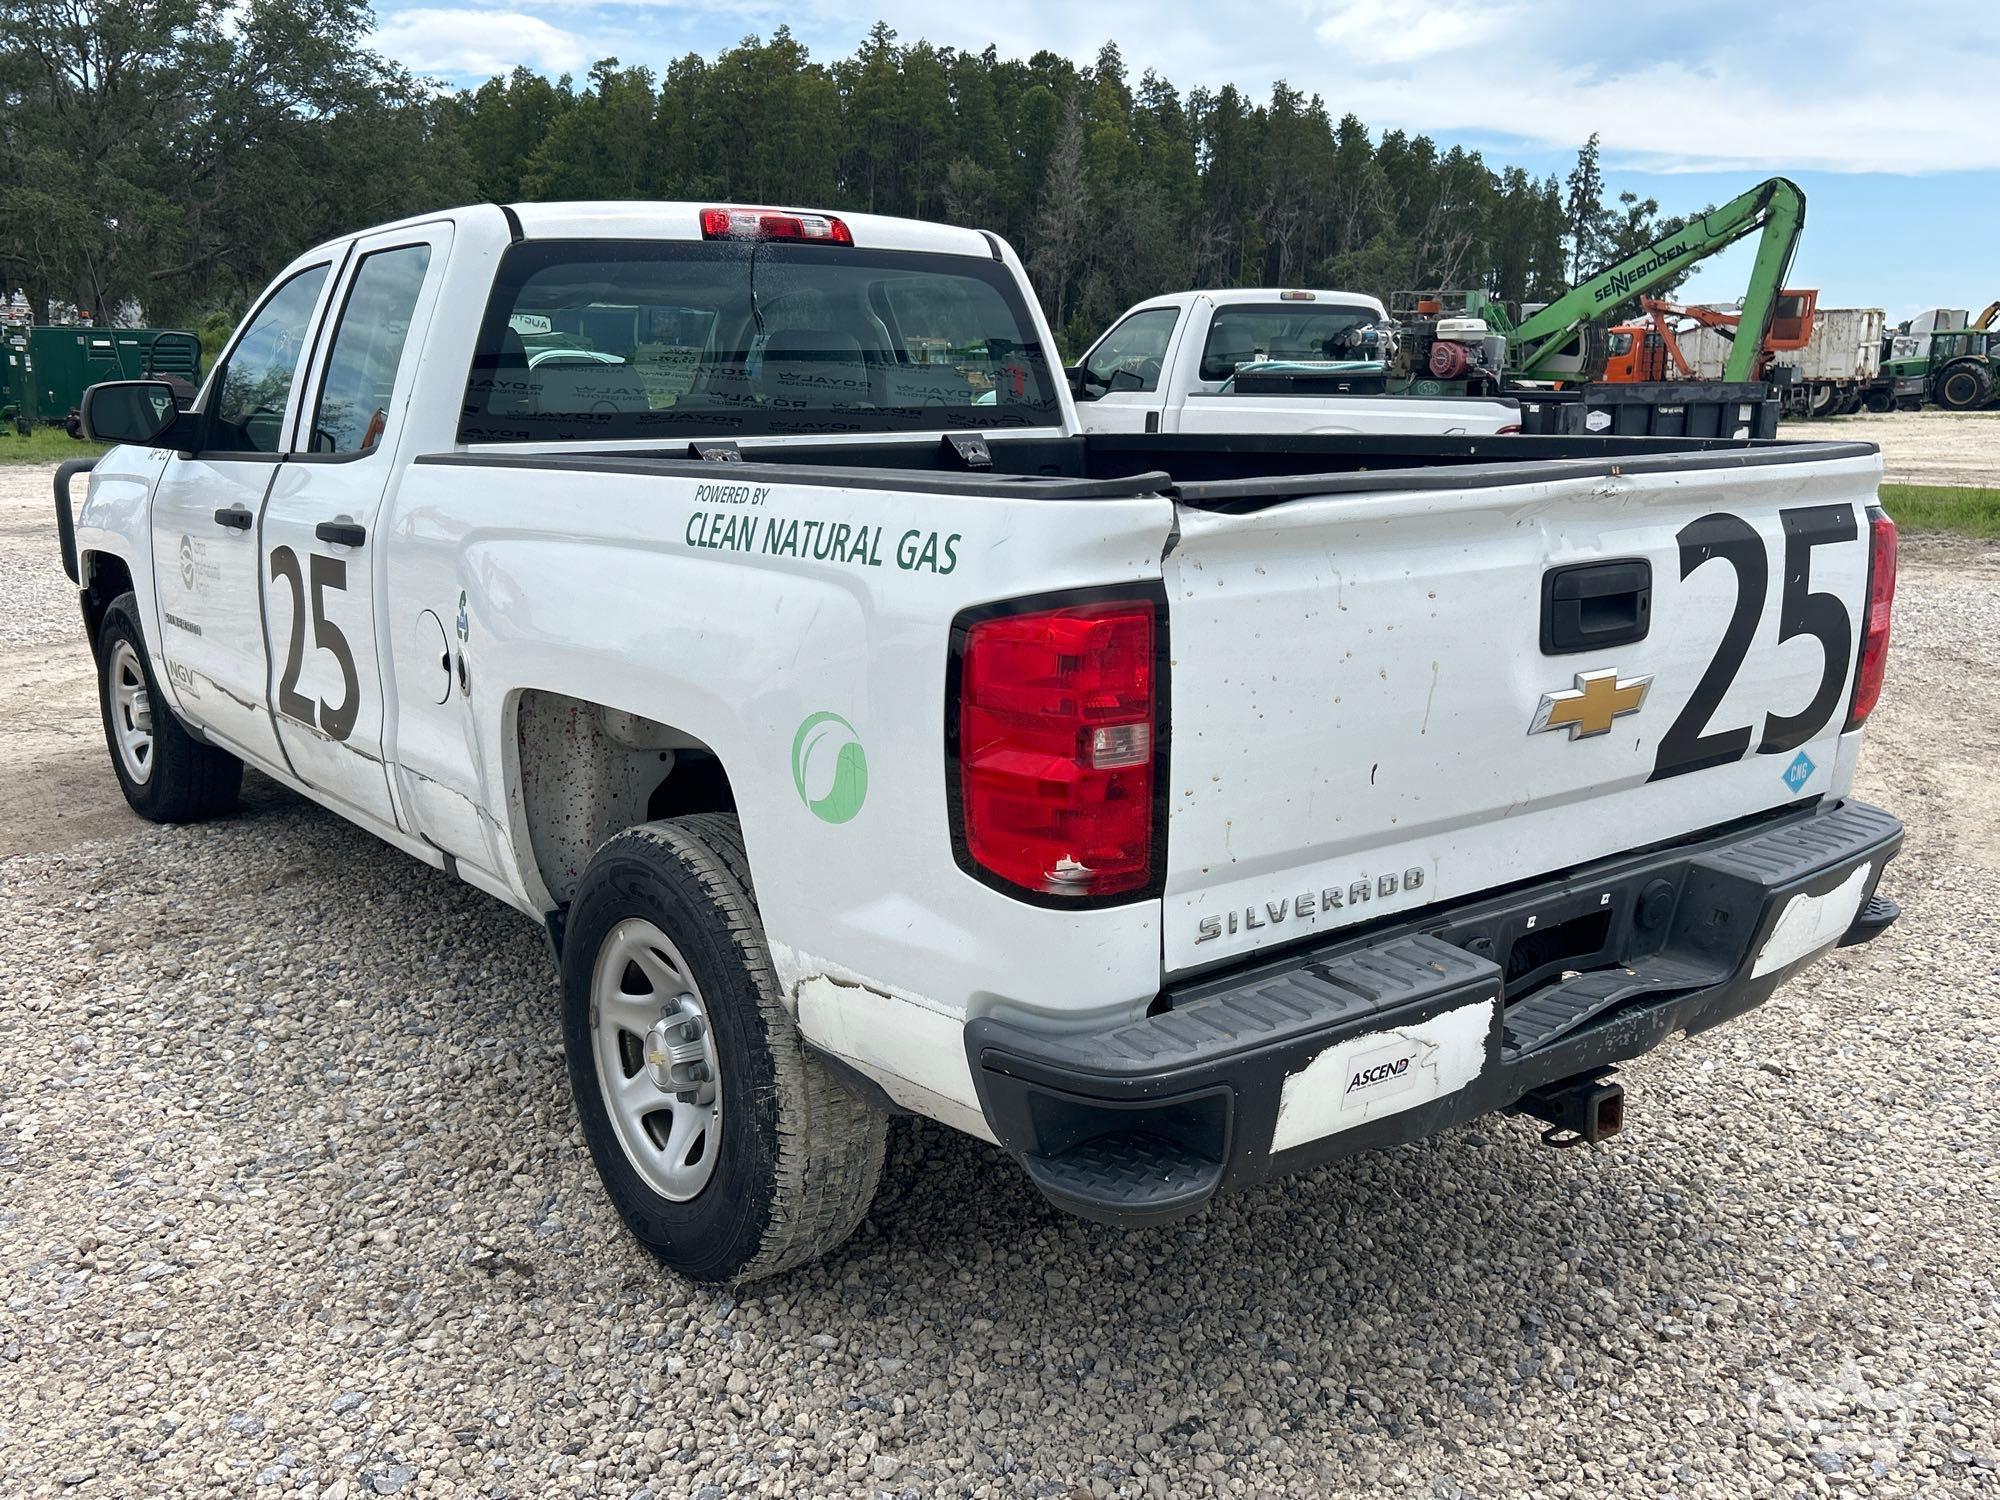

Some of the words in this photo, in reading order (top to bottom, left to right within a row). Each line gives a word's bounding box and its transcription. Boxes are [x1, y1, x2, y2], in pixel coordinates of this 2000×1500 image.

[1594, 241, 1689, 303] SENNEBOGEN
[695, 484, 749, 505] POWERED
[751, 487, 769, 507] BY
[686, 511, 759, 552] CLEAN
[762, 518, 883, 567] NATURAL
[897, 529, 962, 576] GAS
[169, 659, 194, 686] NGV
[271, 545, 361, 742] 25
[1647, 503, 1858, 784] 25
[1790, 762, 1808, 782] CNG
[1197, 866, 1425, 943] SILVERADO
[1346, 1057, 1409, 1094] ASCEND
